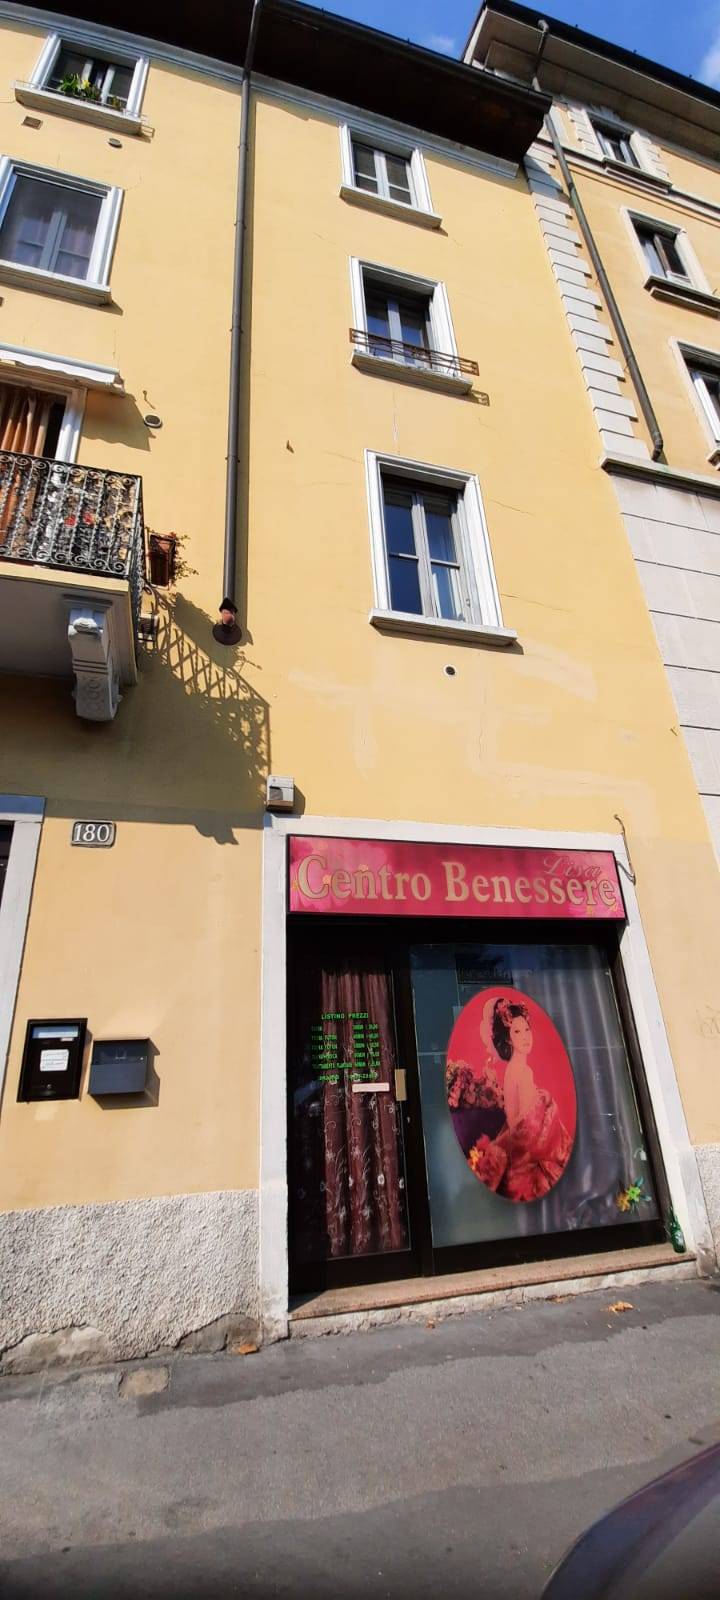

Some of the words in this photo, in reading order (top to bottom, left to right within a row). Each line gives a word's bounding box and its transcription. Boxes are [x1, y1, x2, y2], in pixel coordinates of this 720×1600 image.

[74, 823, 110, 842] 180
[541, 855, 602, 878] Lisa
[297, 854, 432, 901] Centro
[441, 861, 617, 907] Benessere
